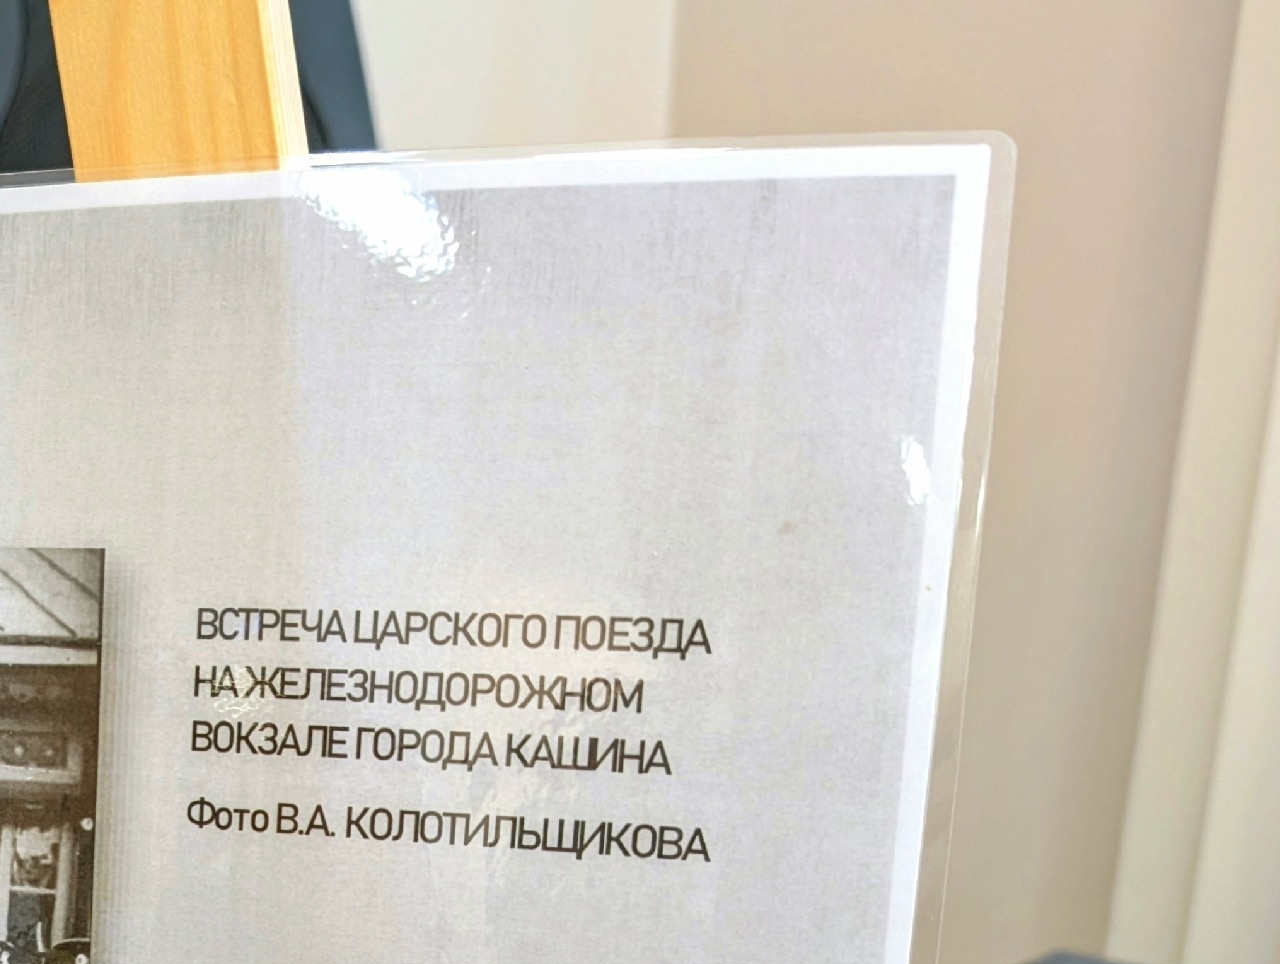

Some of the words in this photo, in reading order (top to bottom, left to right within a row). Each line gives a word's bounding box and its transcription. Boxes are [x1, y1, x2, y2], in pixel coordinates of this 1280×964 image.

[197, 607, 346, 643] ВСТРЕЧА
[354, 610, 546, 651] ЦАРСКОГО
[555, 616, 711, 660] ПОЕЗДА
[193, 666, 239, 698] НА
[243, 667, 644, 714] ЖЕЛЕЗНОДОРОЖНОМ
[191, 720, 349, 759] ВОКЗАЛЕ
[355, 728, 497, 771] ГОРОДА
[506, 734, 671, 775] КАШИНА
[187, 798, 269, 833] Фото
[276, 804, 336, 837] В.А.
[346, 807, 710, 862] КОЛОТИЛЬЩИКОВА
